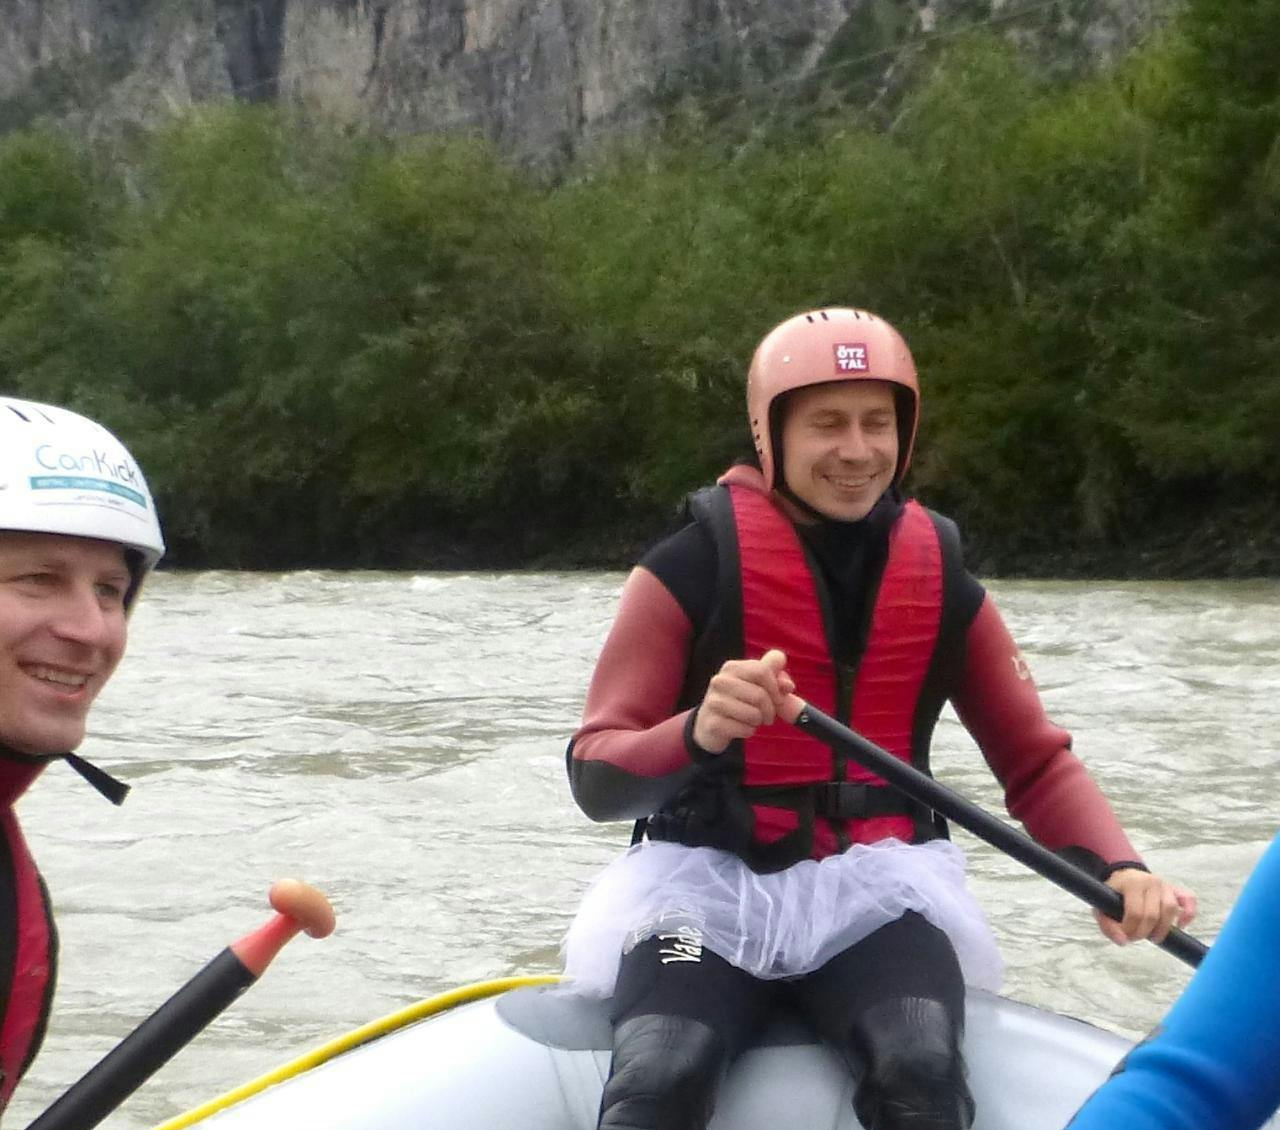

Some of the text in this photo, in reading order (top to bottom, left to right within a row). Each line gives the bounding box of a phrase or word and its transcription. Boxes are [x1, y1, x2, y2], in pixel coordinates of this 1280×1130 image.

[837, 345, 865, 358] ÖTZ
[838, 359, 866, 369] TAL
[35, 444, 139, 487] CanKick
